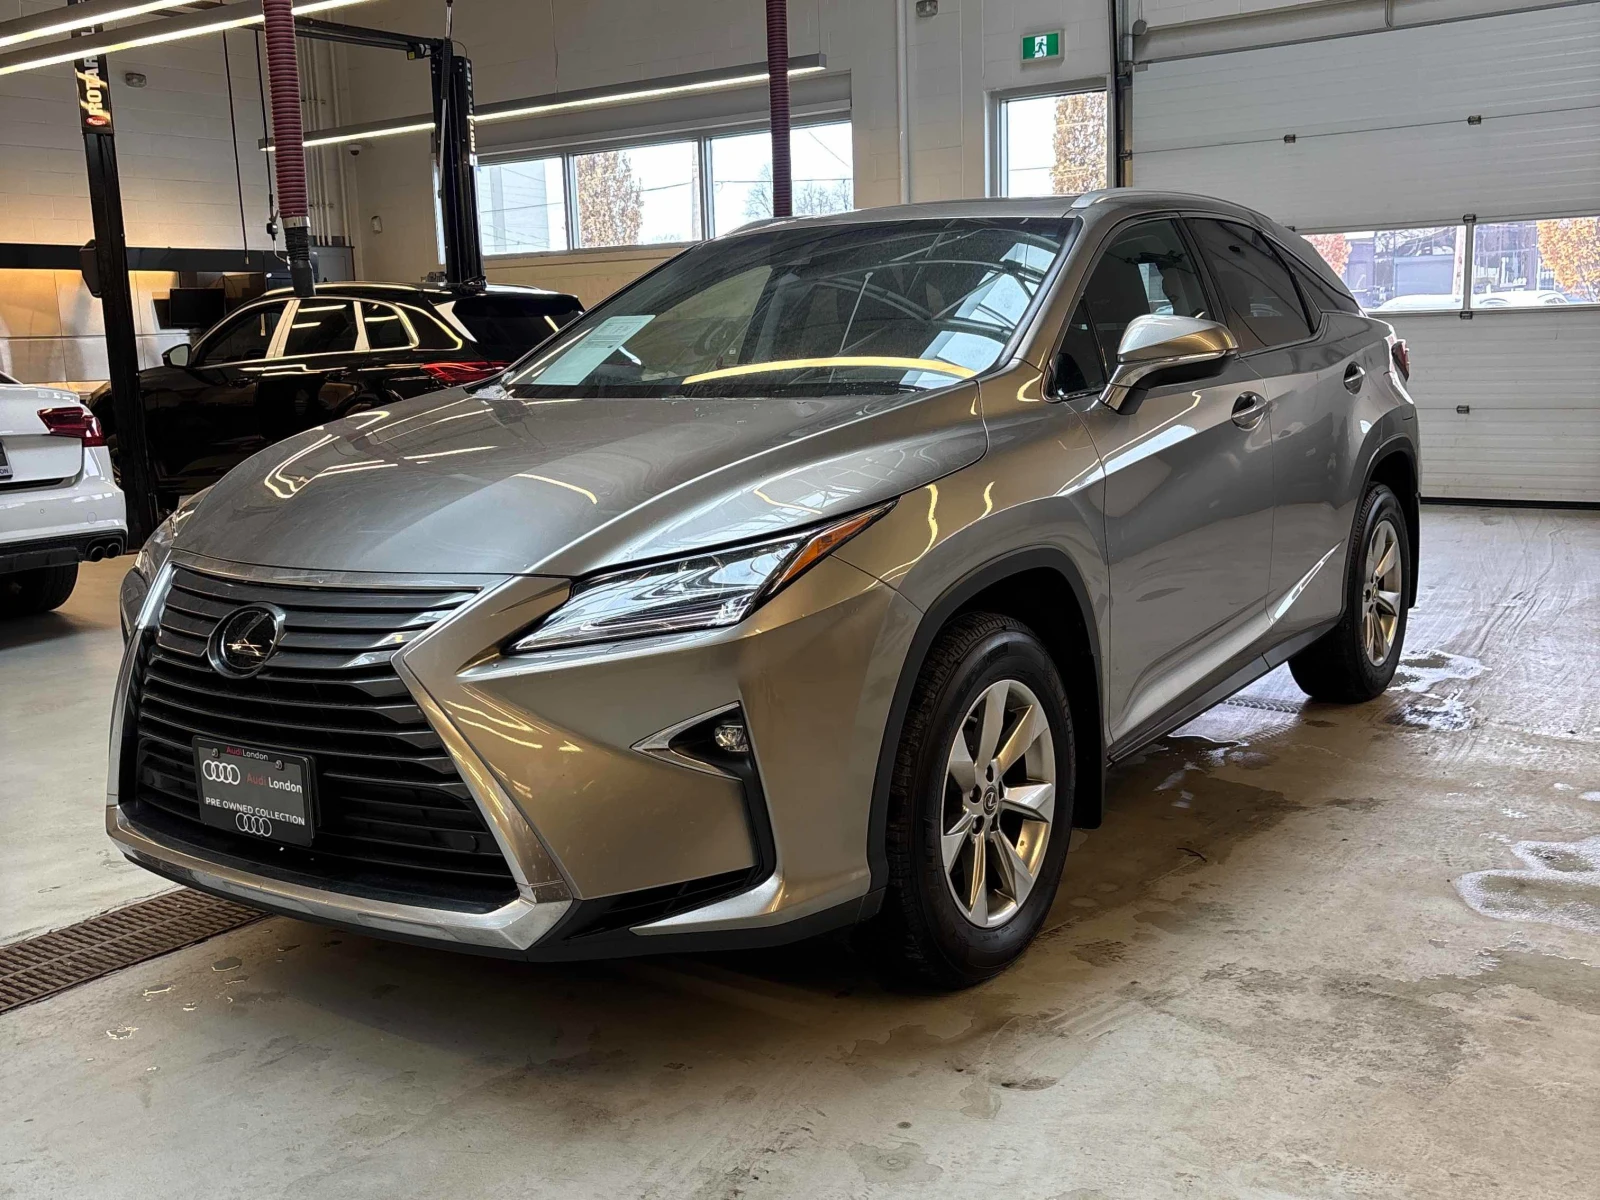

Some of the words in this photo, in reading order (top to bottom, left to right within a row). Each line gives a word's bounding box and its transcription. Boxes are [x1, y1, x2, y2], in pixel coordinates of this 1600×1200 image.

[84, 55, 103, 116] ROTAR
[226, 746, 242, 756] Audi
[242, 749, 268, 761] London
[246, 772, 267, 786] Audi
[268, 777, 302, 793] London
[205, 797, 221, 808] PRE
[222, 800, 253, 814] OWNED
[255, 807, 305, 826] COLLECTION
